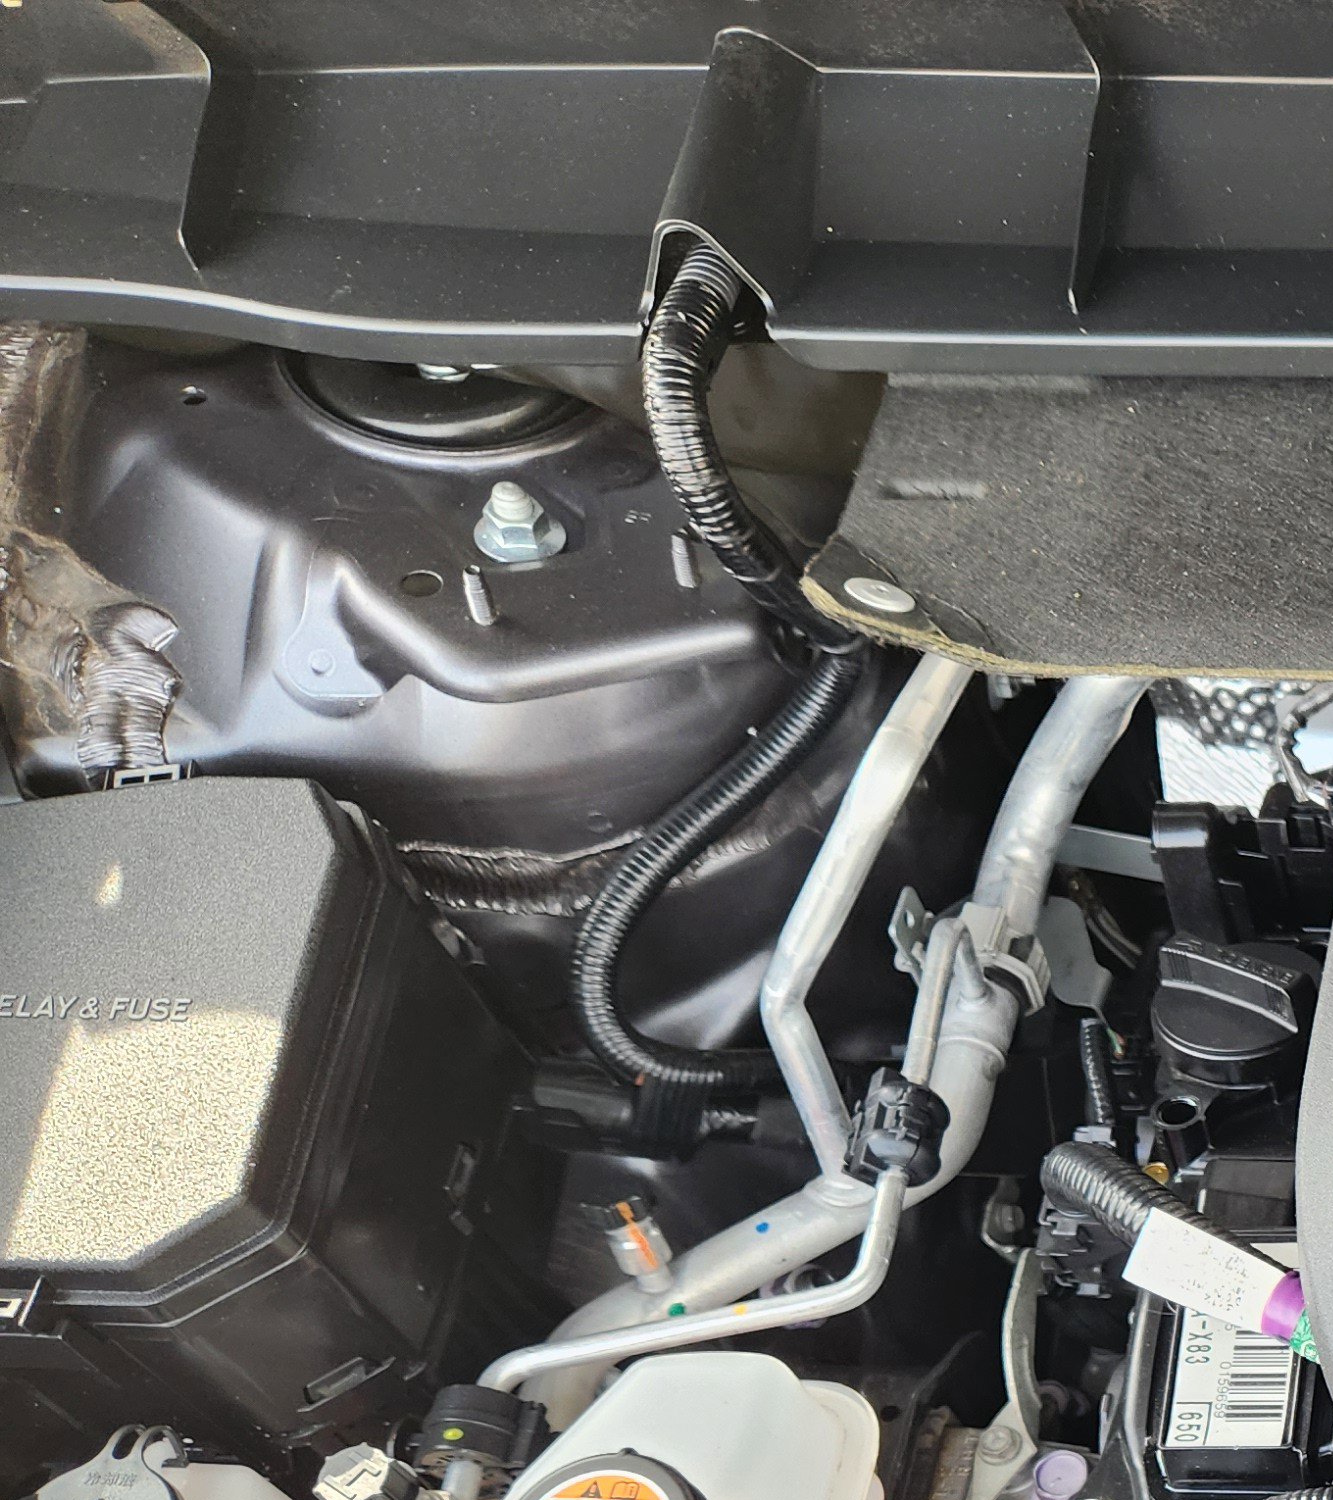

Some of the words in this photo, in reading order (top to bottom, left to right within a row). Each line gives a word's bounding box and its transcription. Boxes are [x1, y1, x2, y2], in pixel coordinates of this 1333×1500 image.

[0, 994, 79, 1019] ELAY
[79, 997, 100, 1019] &
[109, 997, 193, 1021] FUSE
[1212, 1360, 1232, 1419] 0159659
[1173, 1409, 1202, 1444] 650
